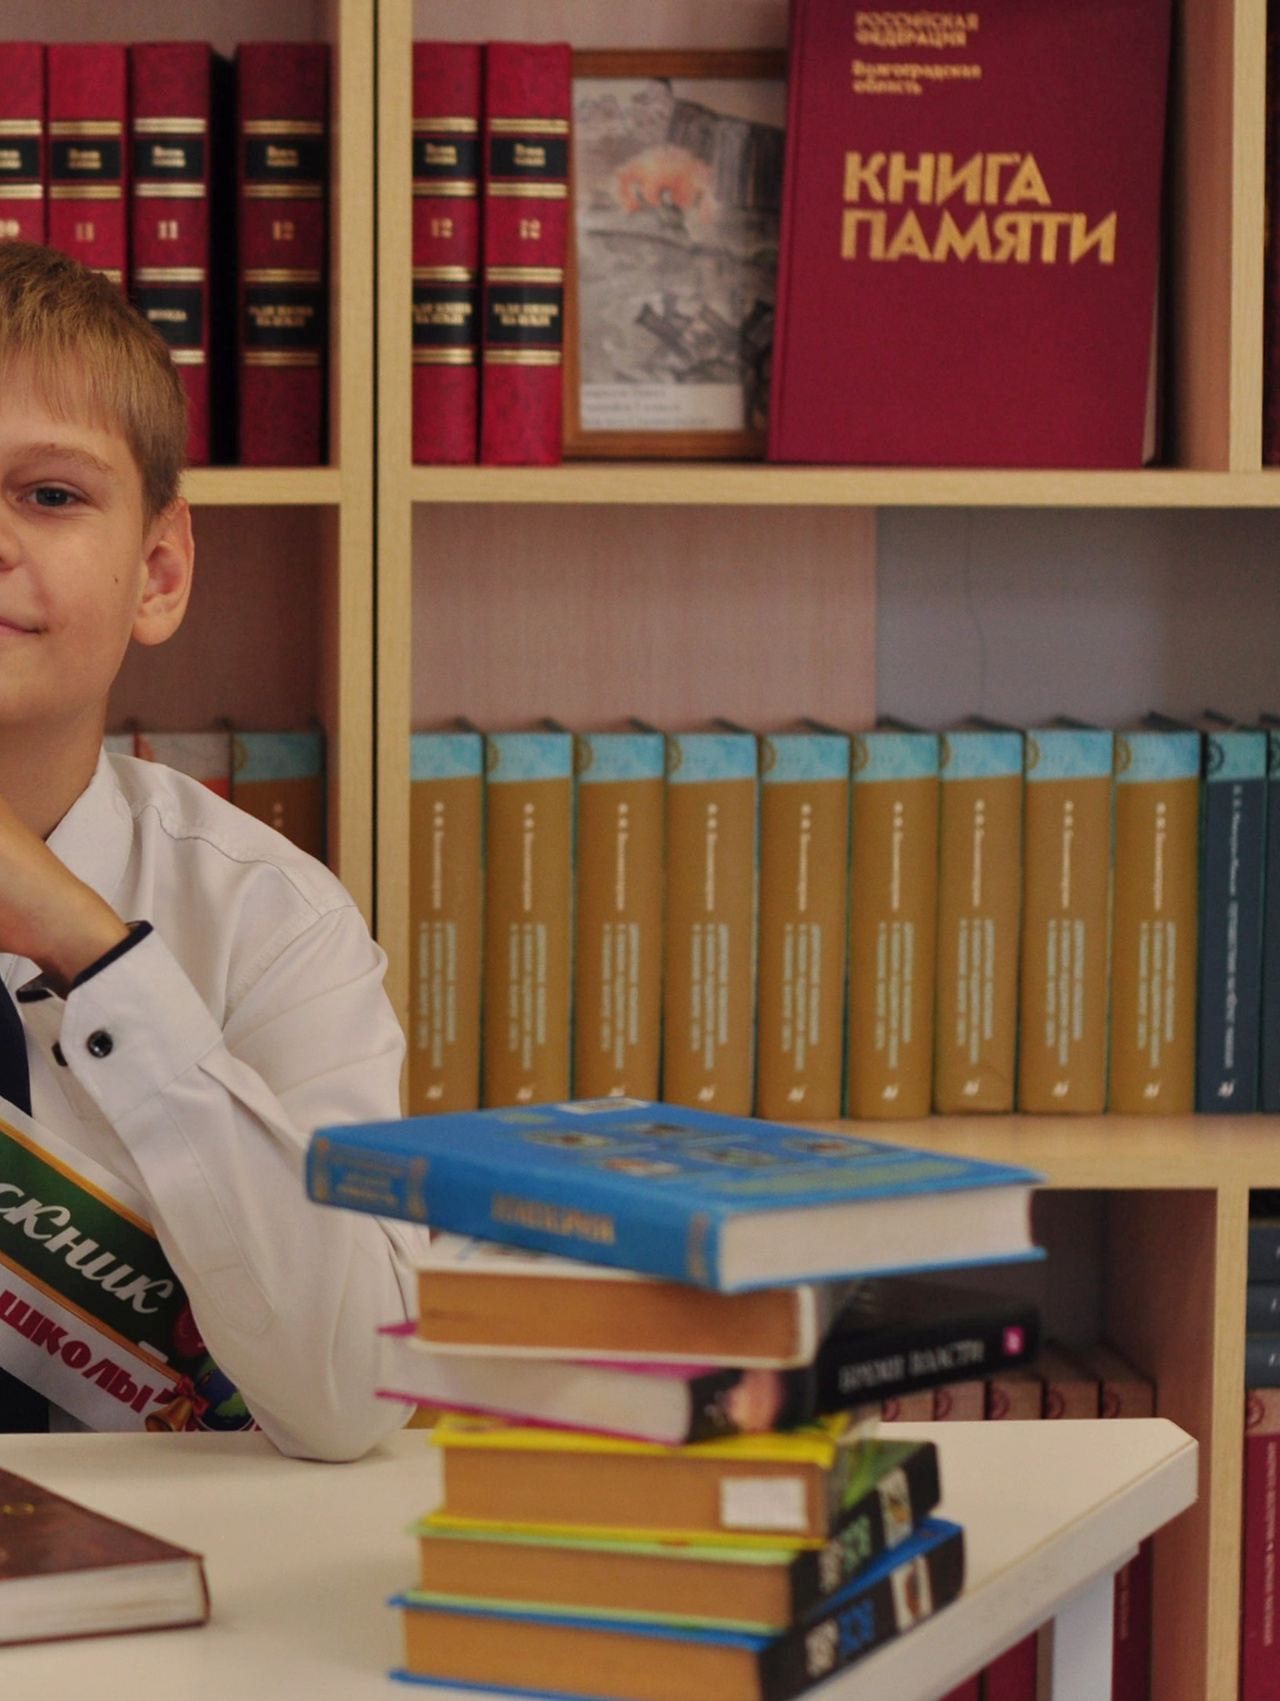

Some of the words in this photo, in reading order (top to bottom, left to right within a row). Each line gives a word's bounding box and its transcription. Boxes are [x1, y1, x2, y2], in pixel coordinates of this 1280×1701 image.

[843, 151, 1052, 206] КНИГА
[156, 219, 179, 241] 11
[271, 219, 296, 241] 12
[429, 217, 455, 240] 12
[840, 208, 1117, 264] ПАМЯТИ
